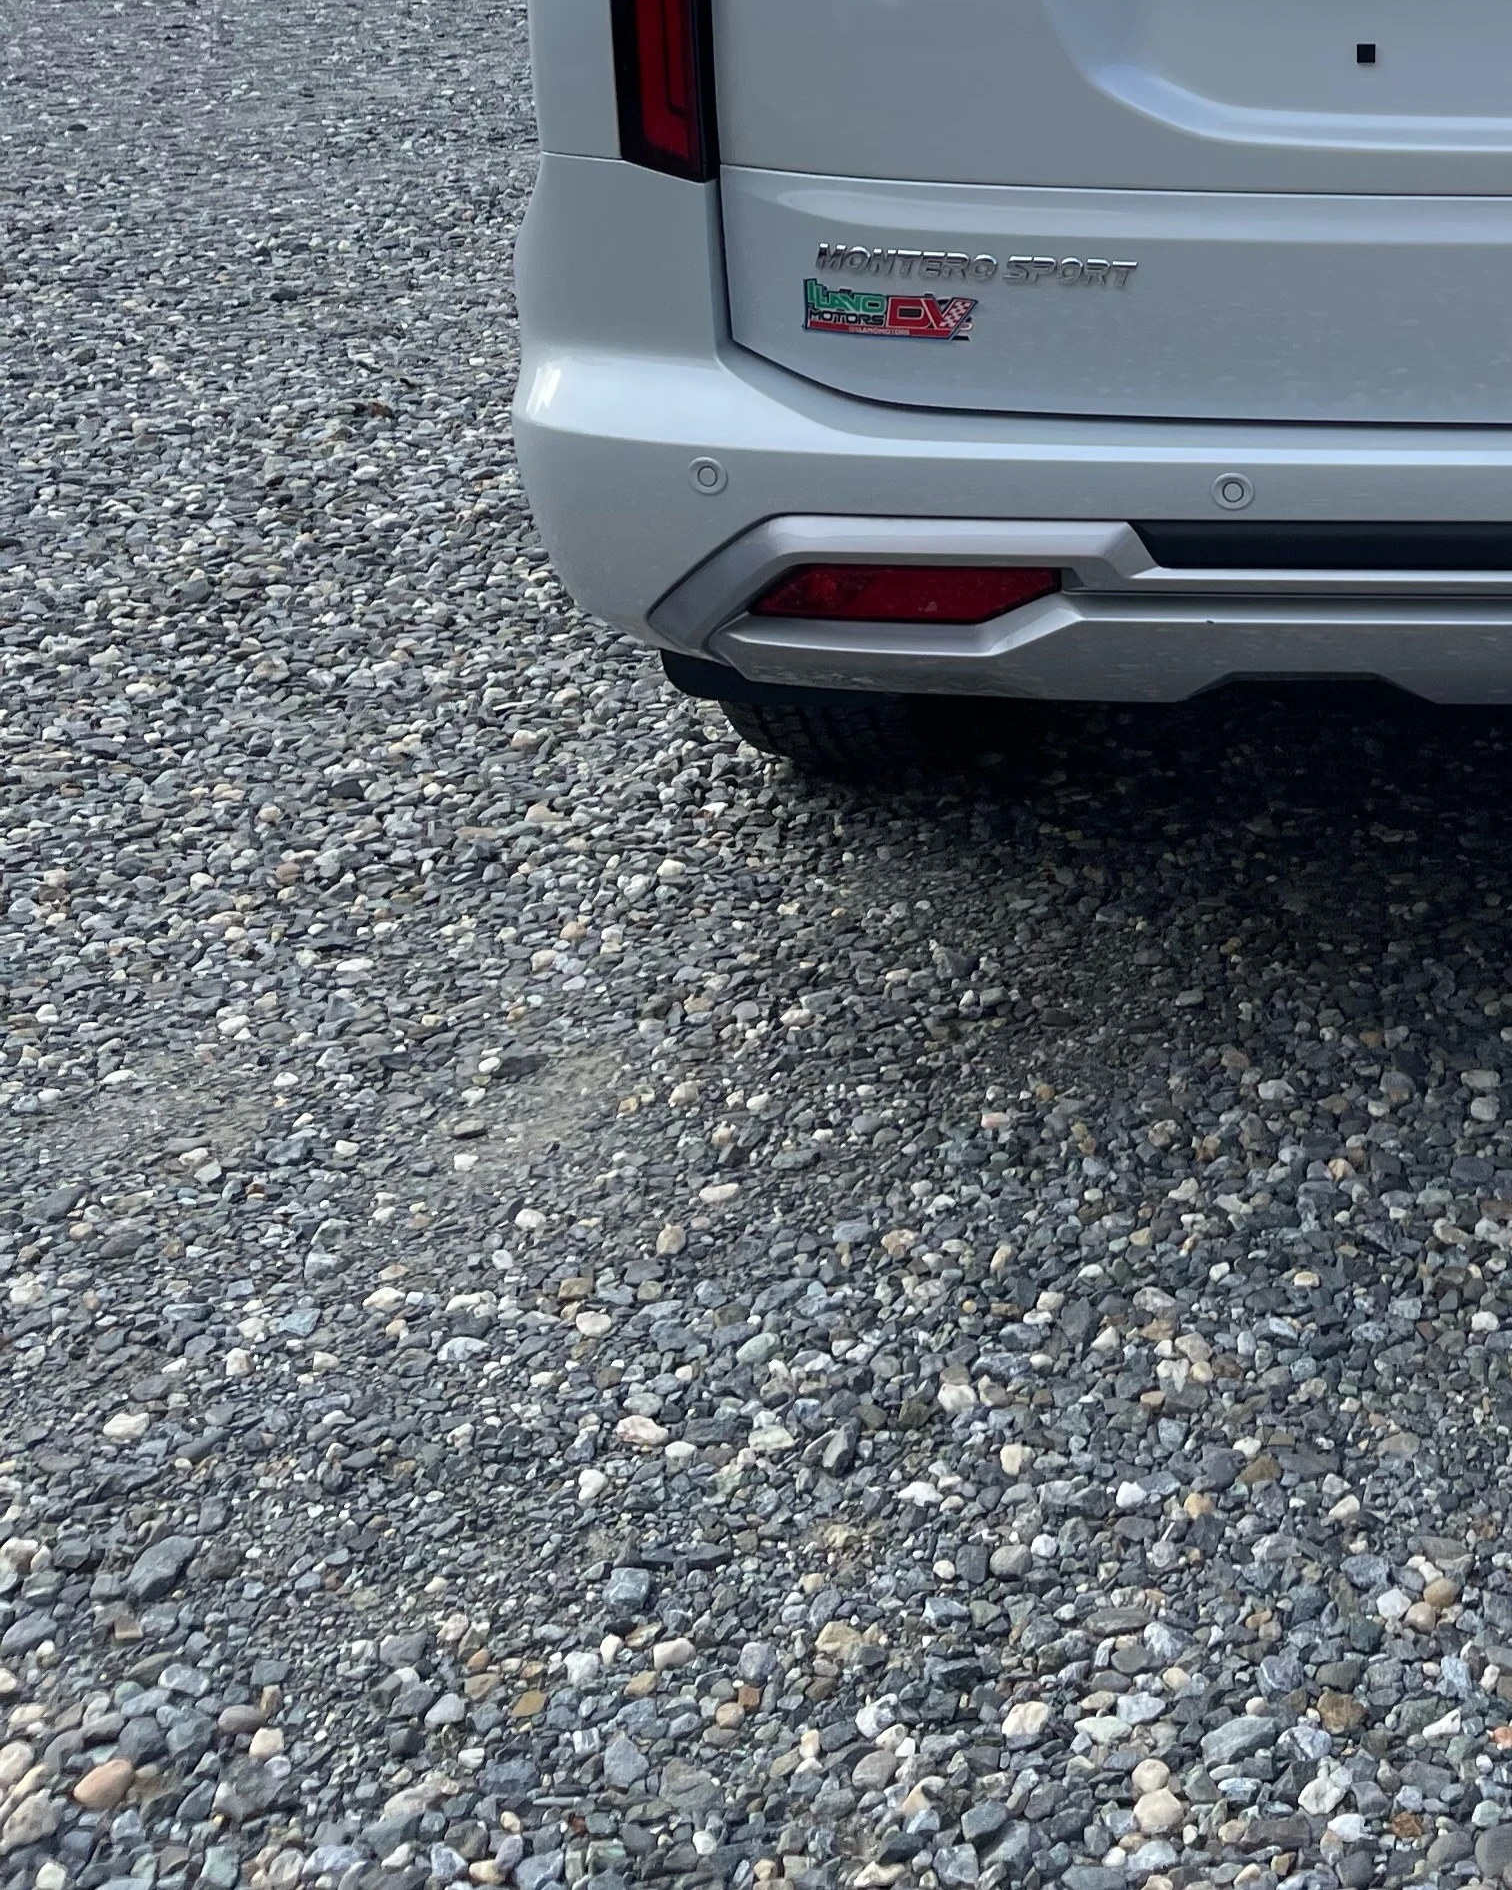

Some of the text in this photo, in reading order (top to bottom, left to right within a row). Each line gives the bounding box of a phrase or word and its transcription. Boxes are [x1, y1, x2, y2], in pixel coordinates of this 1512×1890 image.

[816, 242, 1139, 288] MONTERO SPORT
[808, 309, 886, 327] MOTORS
